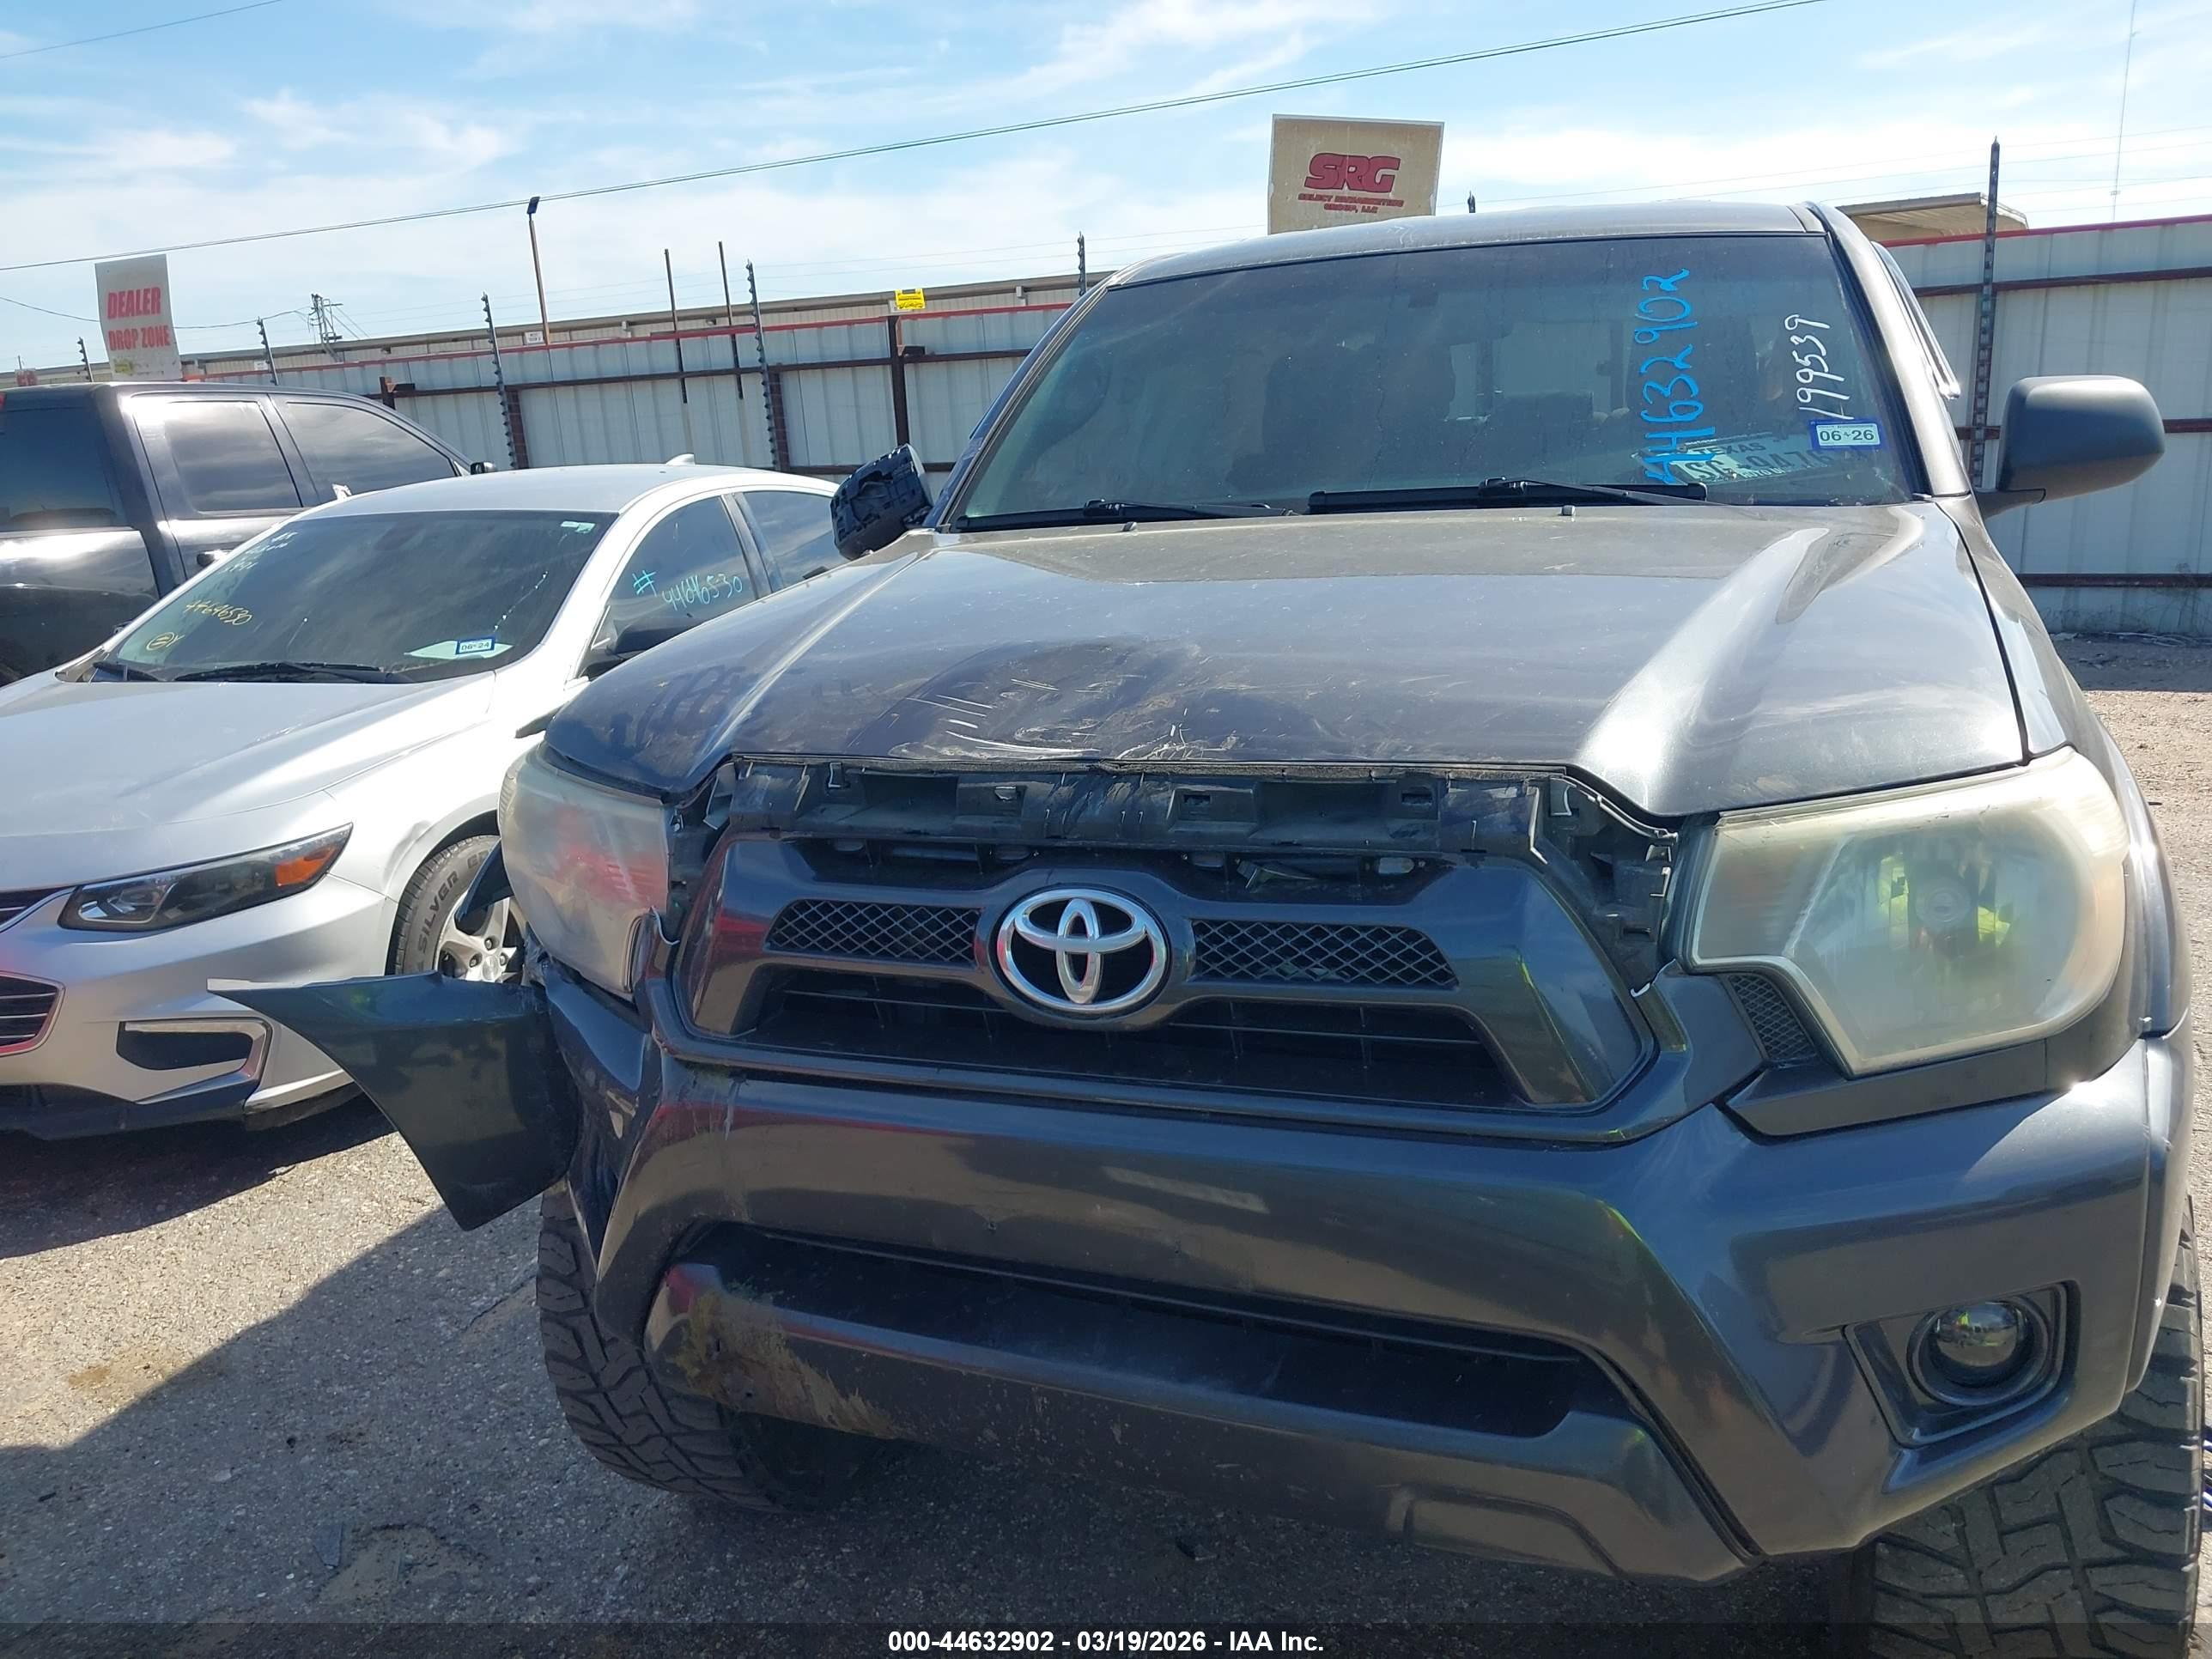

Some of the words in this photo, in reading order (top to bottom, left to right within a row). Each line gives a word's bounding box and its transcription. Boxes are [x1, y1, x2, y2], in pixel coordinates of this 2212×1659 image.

[1304, 153, 1401, 193] SRG
[107, 287, 161, 319] DEALER
[108, 328, 138, 351] DROP
[140, 325, 171, 349] ZONE
[1633, 268, 1716, 483] 44632902
[1784, 313, 1854, 420] 199539
[632, 570, 659, 598] #
[417, 870, 459, 953] SILVER
